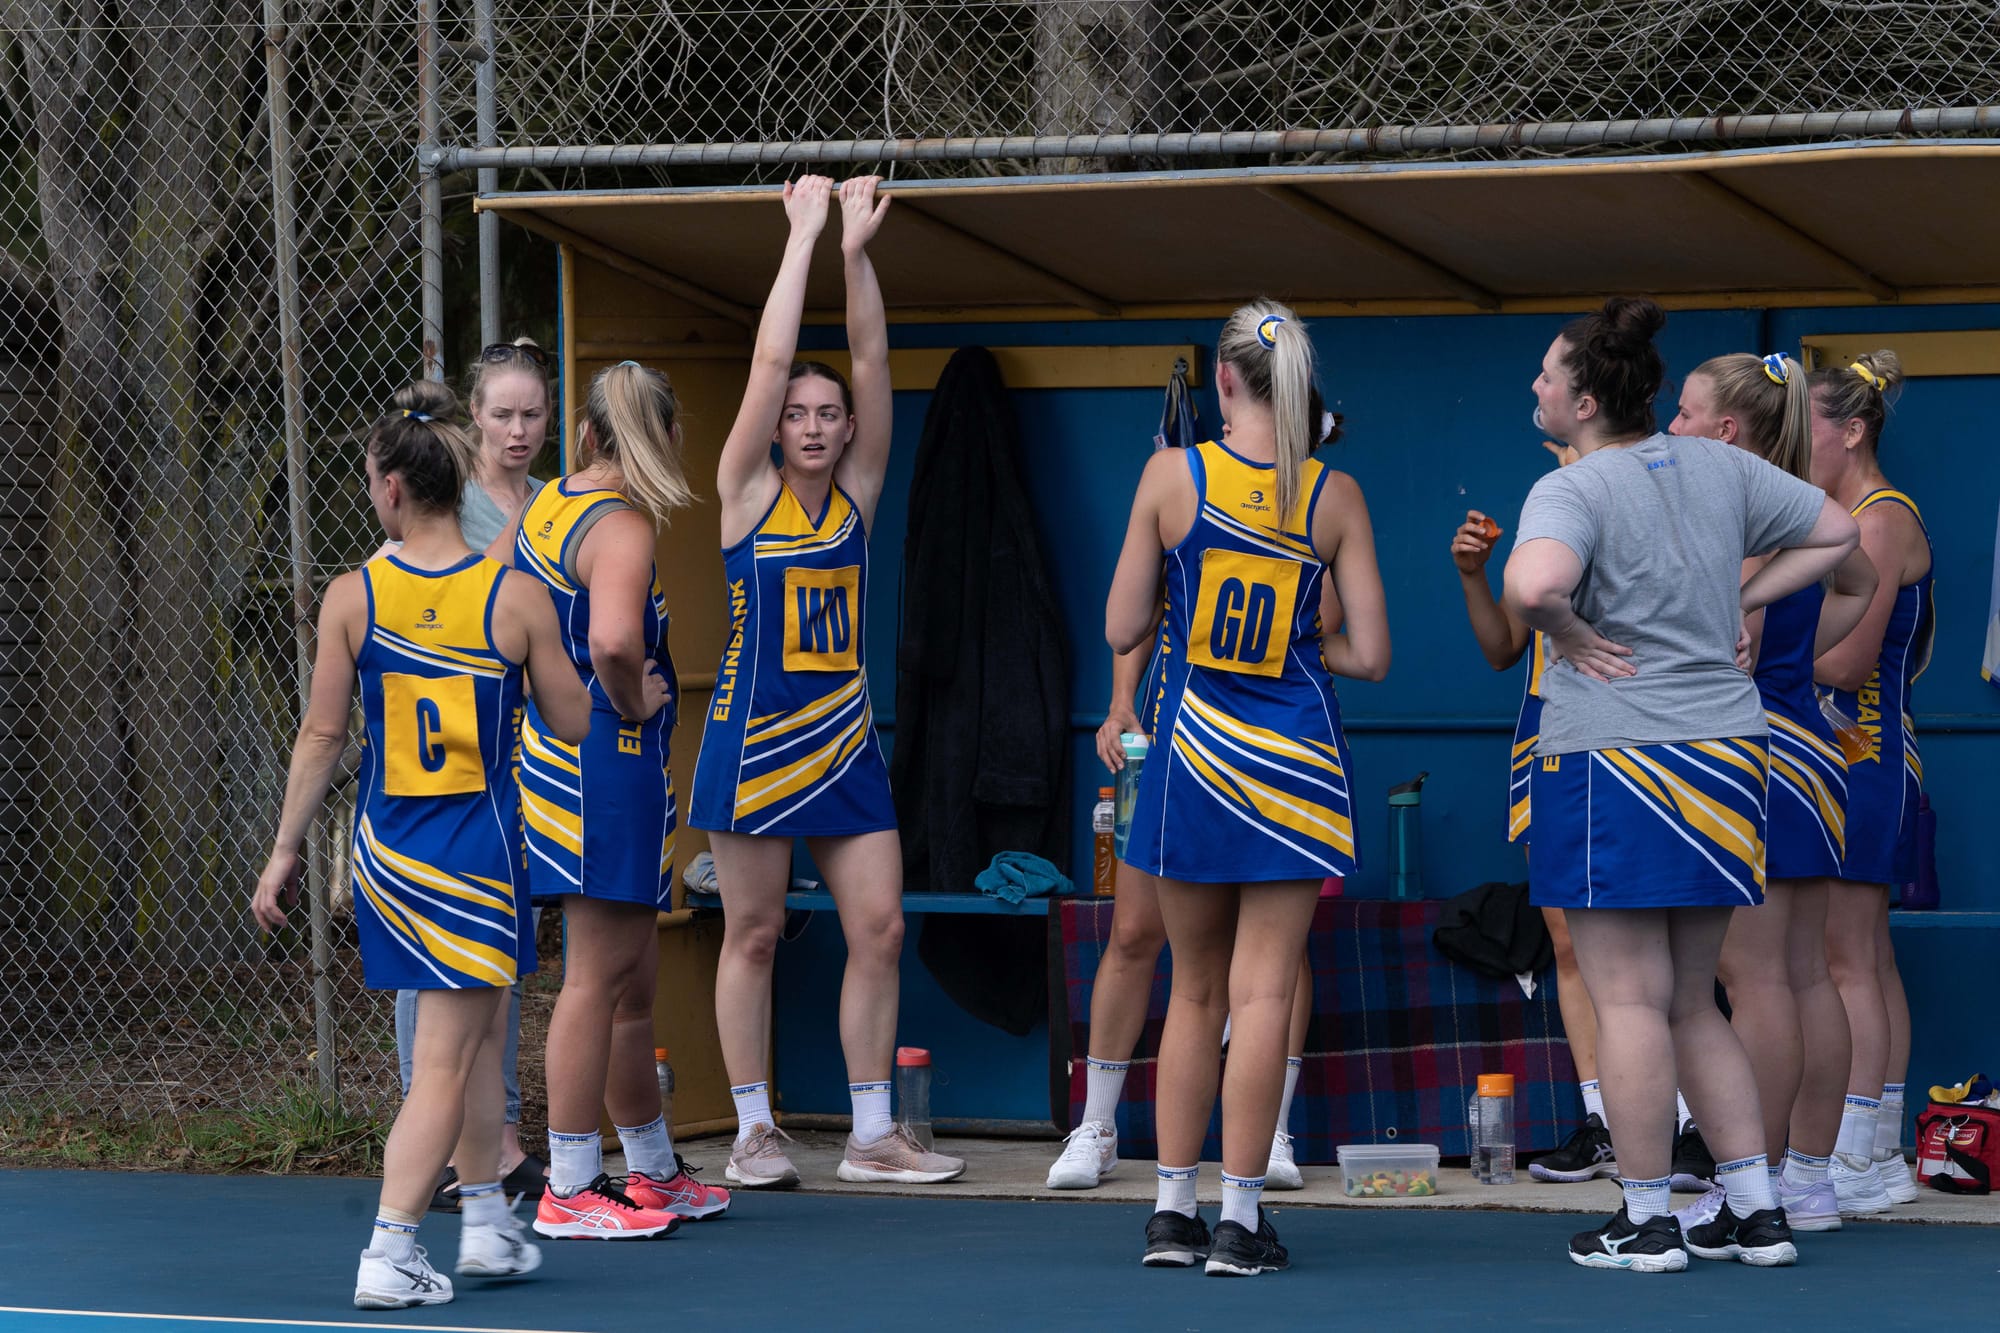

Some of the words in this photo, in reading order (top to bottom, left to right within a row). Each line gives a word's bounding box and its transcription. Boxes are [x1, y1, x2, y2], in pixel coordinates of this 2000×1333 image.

[796, 585, 851, 654] WD
[1209, 577, 1276, 664] GD
[416, 697, 446, 773] C
